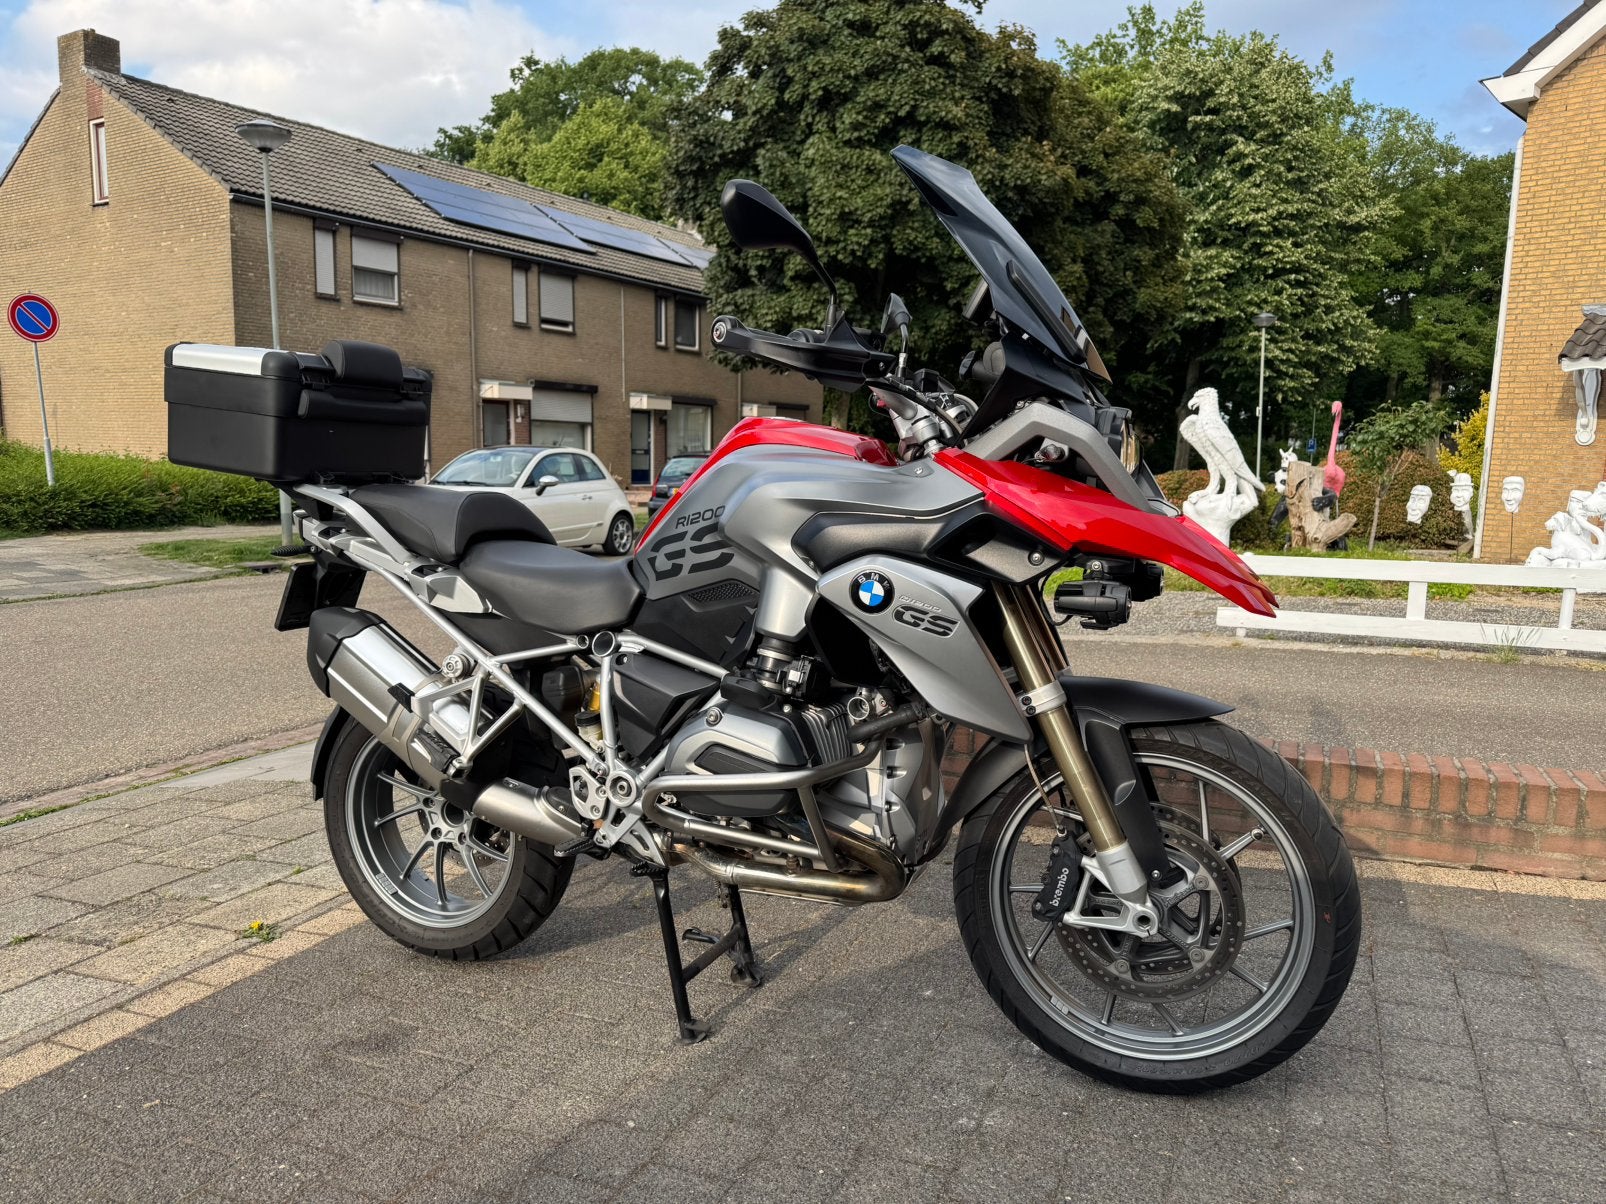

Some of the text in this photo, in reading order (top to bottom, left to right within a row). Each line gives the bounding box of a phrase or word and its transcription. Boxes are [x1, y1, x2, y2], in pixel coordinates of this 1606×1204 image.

[675, 505, 726, 529] R1200
[647, 522, 735, 581] GS
[857, 572, 892, 591] BMW
[893, 604, 960, 637] GS
[1049, 867, 1070, 907] brembo
